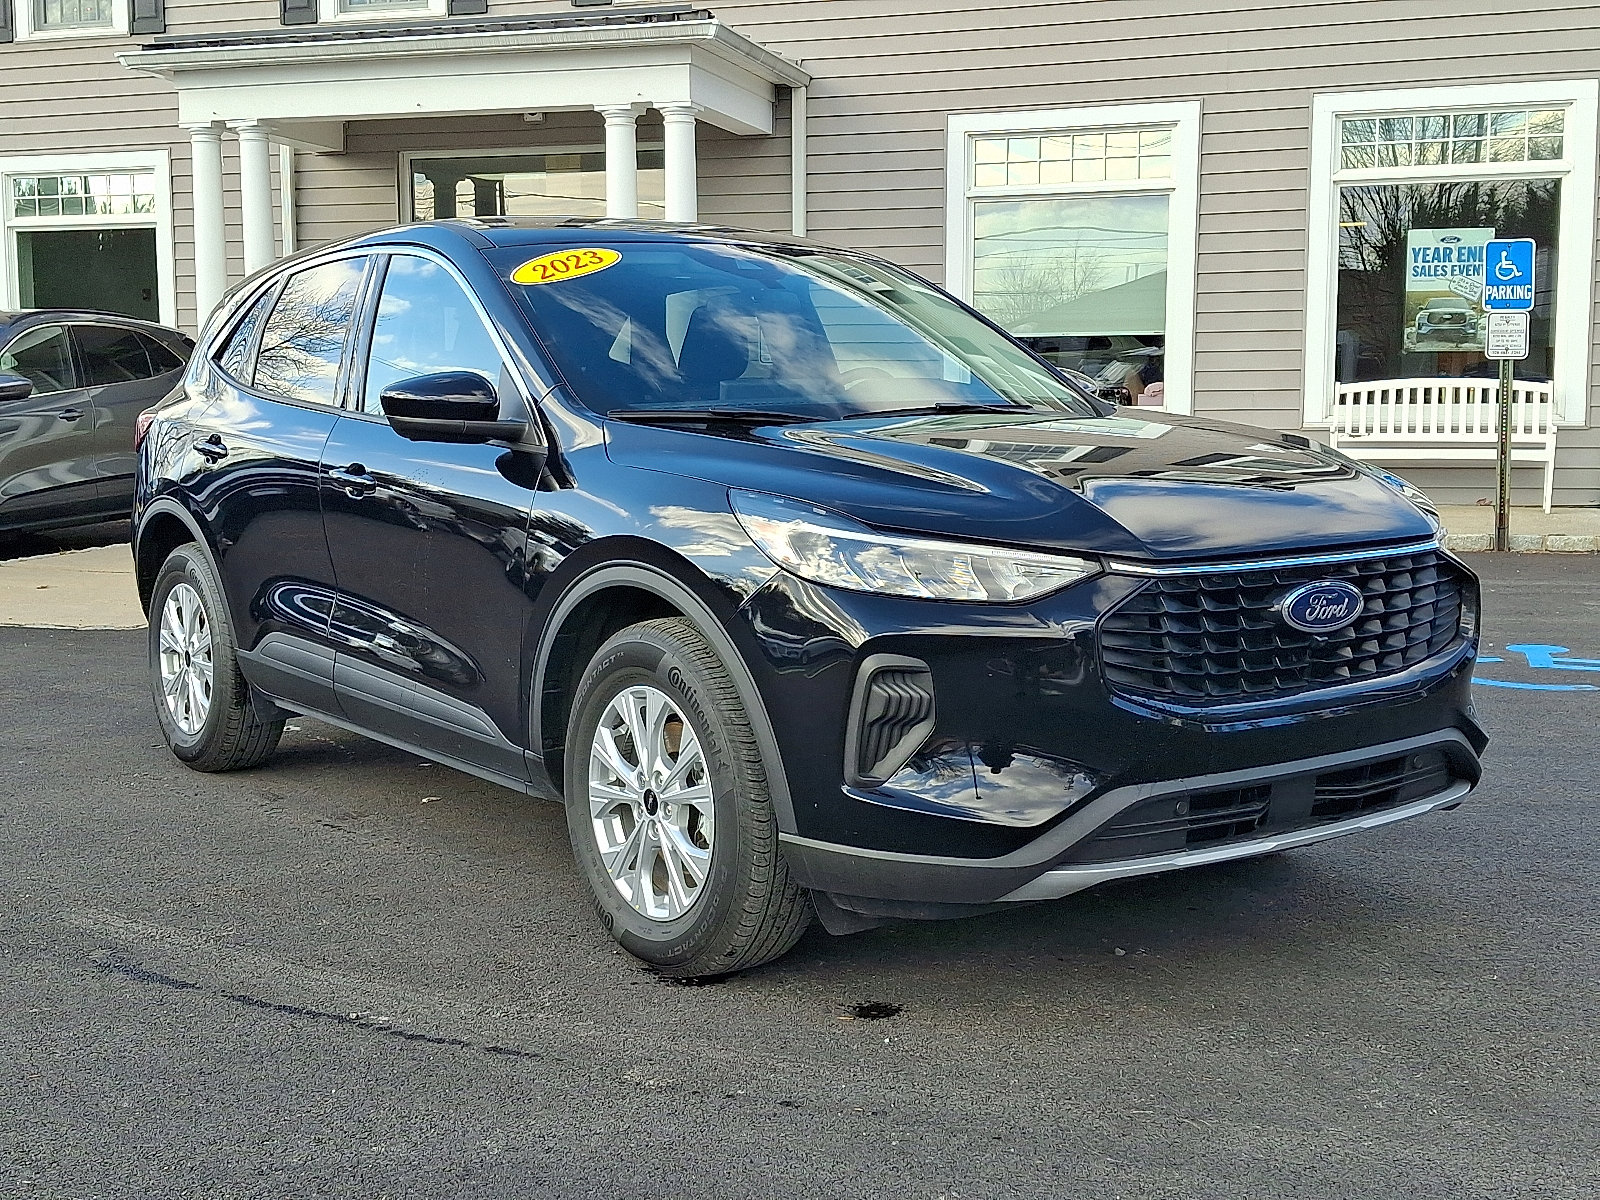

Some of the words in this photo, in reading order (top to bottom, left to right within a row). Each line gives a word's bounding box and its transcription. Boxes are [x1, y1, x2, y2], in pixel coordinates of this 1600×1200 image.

[532, 250, 604, 280] 2023
[1411, 247, 1453, 263] YEAR
[1412, 264, 1448, 277] SALES
[1485, 285, 1532, 301] PARKING
[1305, 591, 1349, 621] Ford
[668, 666, 722, 757] Continental
